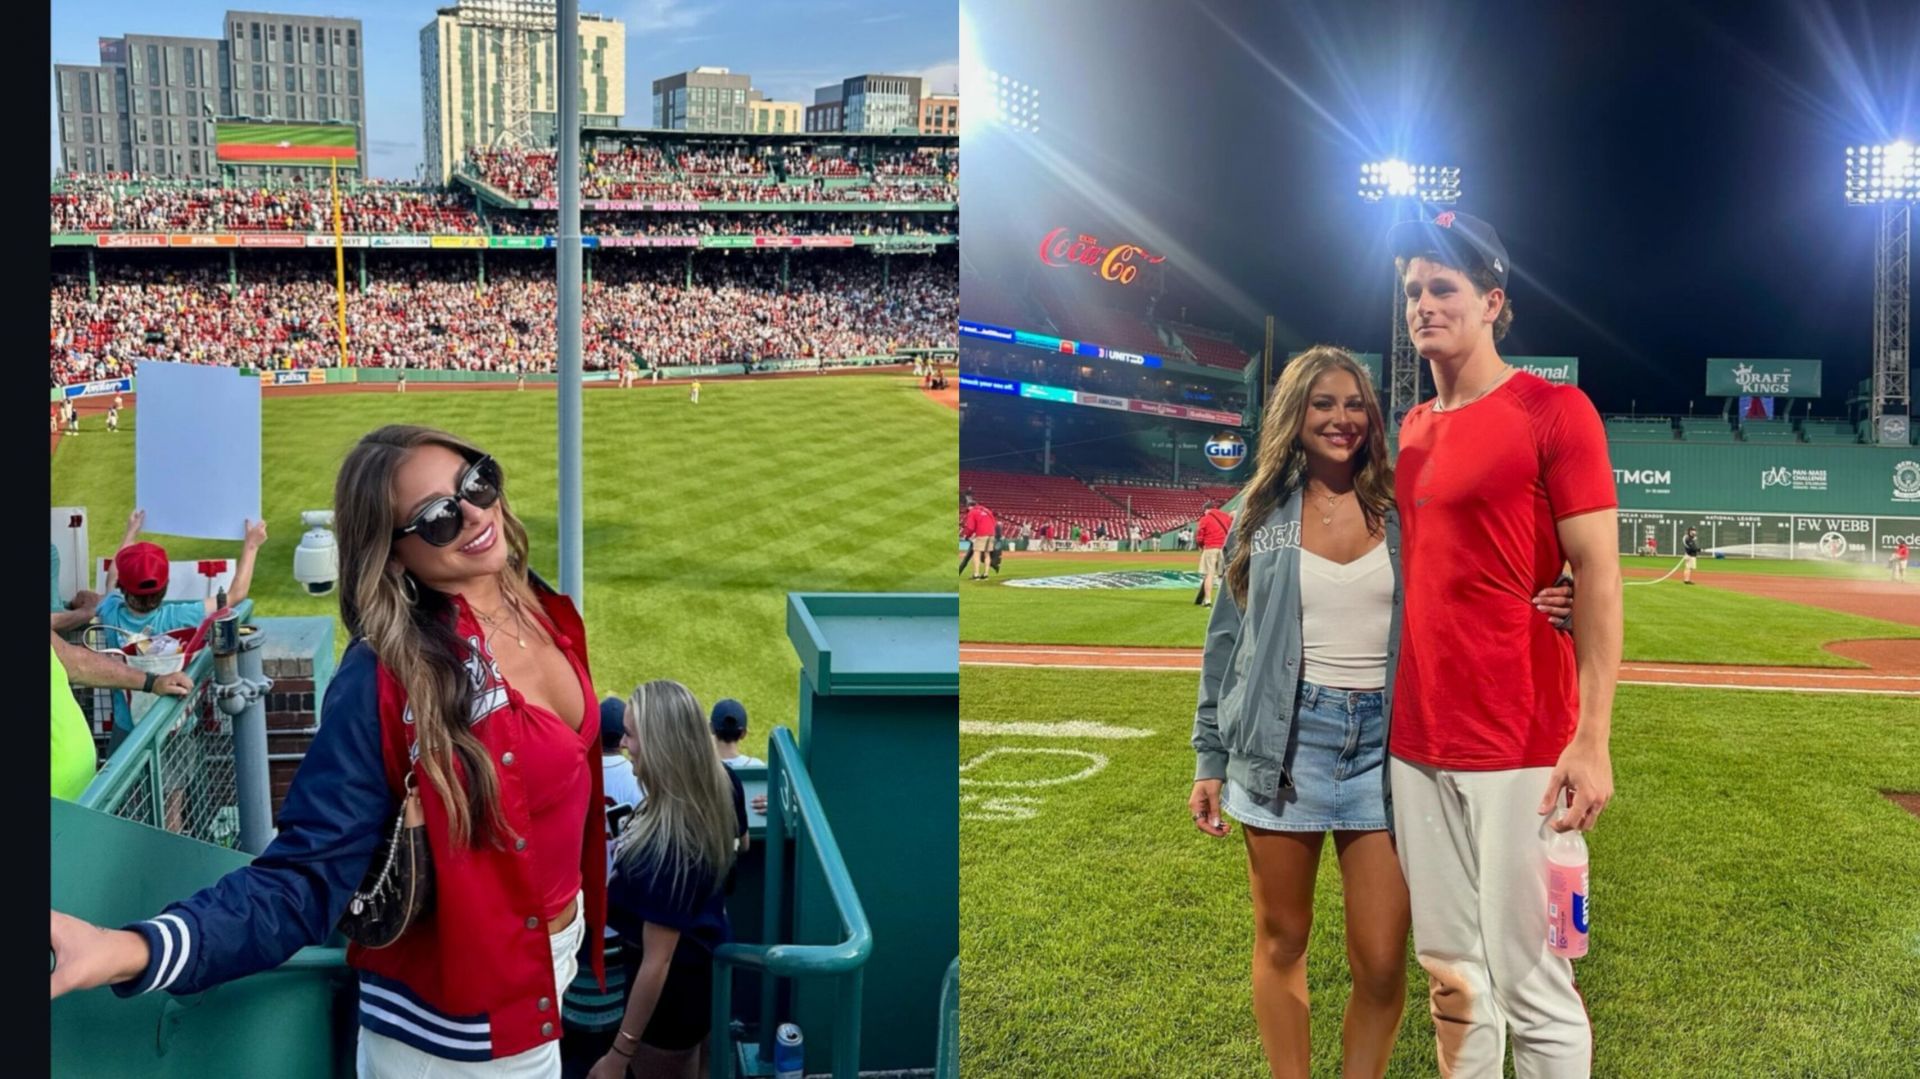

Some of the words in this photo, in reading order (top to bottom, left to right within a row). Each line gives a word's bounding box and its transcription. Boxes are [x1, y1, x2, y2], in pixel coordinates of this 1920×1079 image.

[1109, 349, 1145, 365] UNITED
[1735, 372, 1792, 386] DRAFT
[1742, 383, 1790, 394] KINGS
[1206, 443, 1245, 457] Gulf
[1612, 469, 1672, 485] TMGM
[1826, 519, 1870, 532] WEBB
